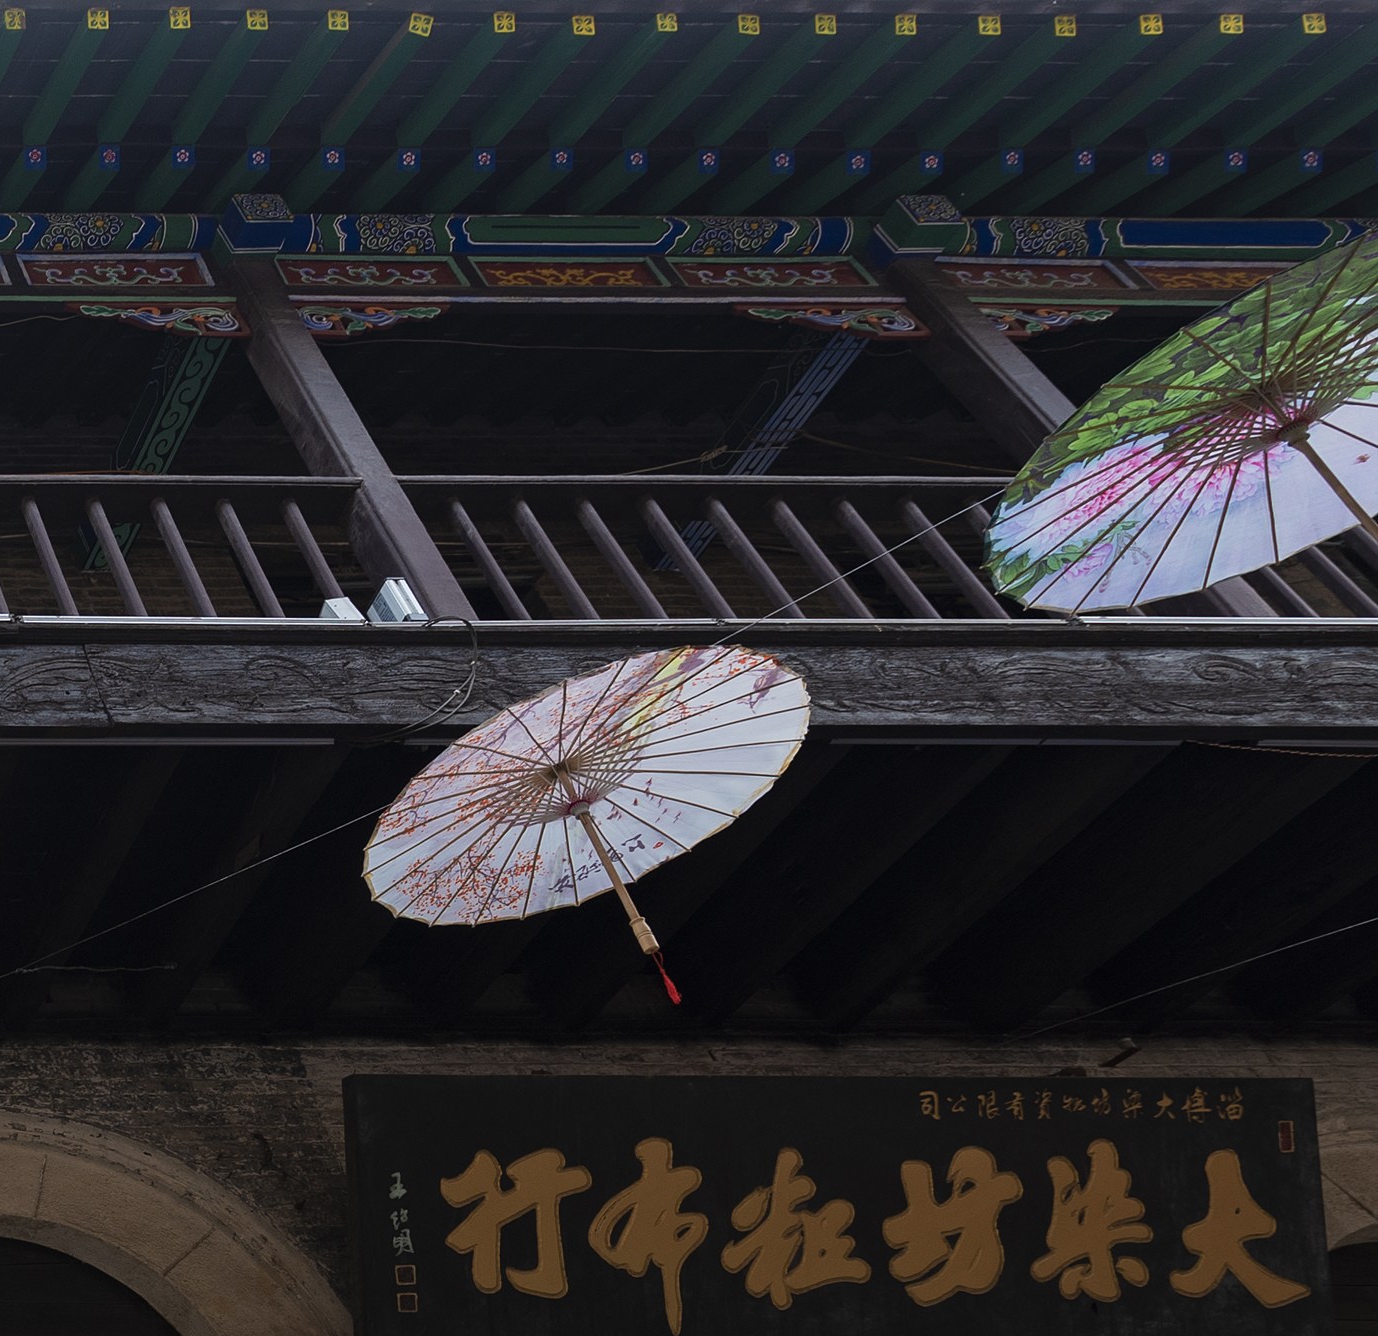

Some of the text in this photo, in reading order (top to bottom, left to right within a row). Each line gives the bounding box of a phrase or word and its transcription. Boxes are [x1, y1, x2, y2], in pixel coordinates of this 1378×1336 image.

[440, 1137, 1310, 1336] 大染坊粗布行
